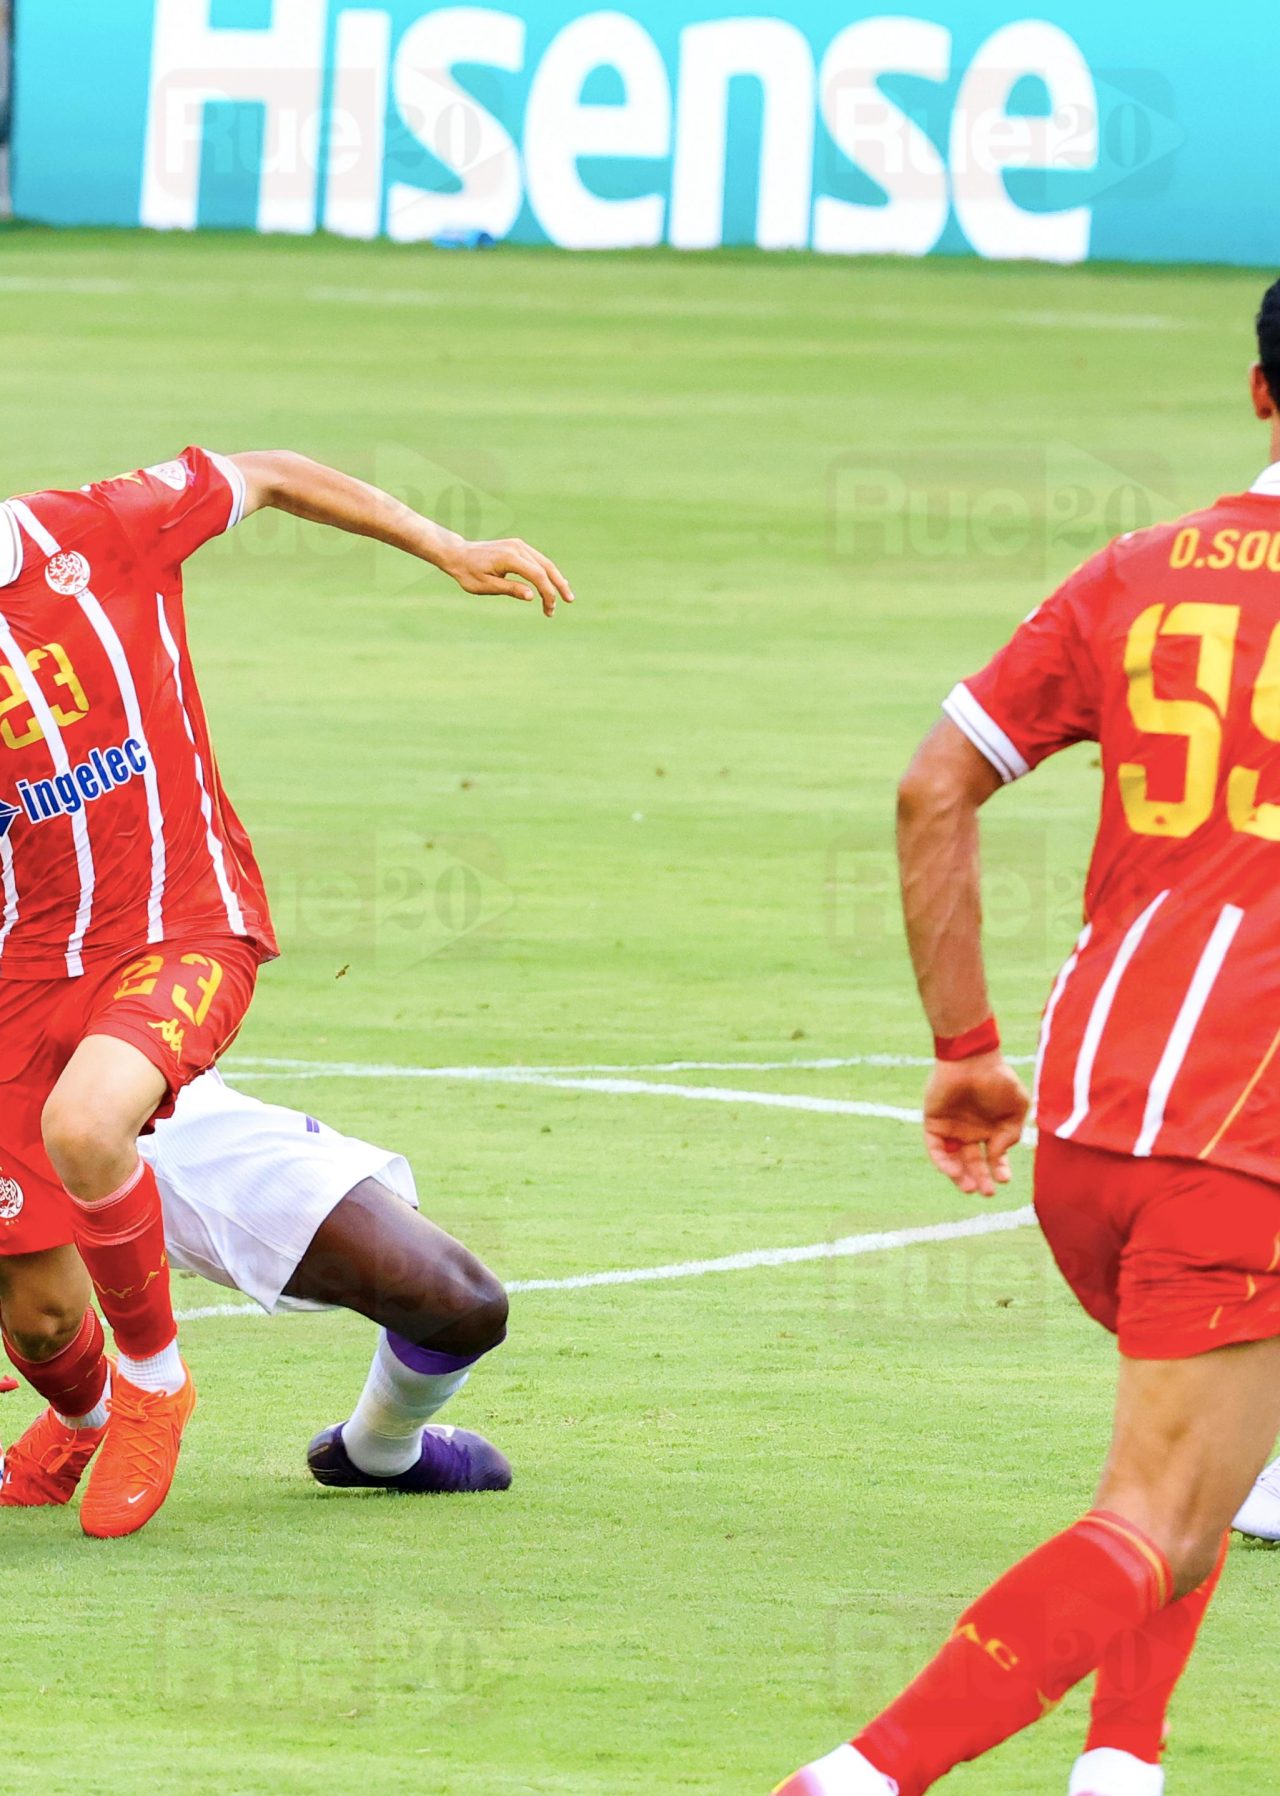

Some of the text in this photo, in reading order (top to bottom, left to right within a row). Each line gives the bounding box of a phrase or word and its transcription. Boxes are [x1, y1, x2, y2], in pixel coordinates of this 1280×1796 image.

[138, 0, 1098, 263] Hisense
[17, 738, 147, 822] ingelec
[113, 953, 223, 1027] 23
